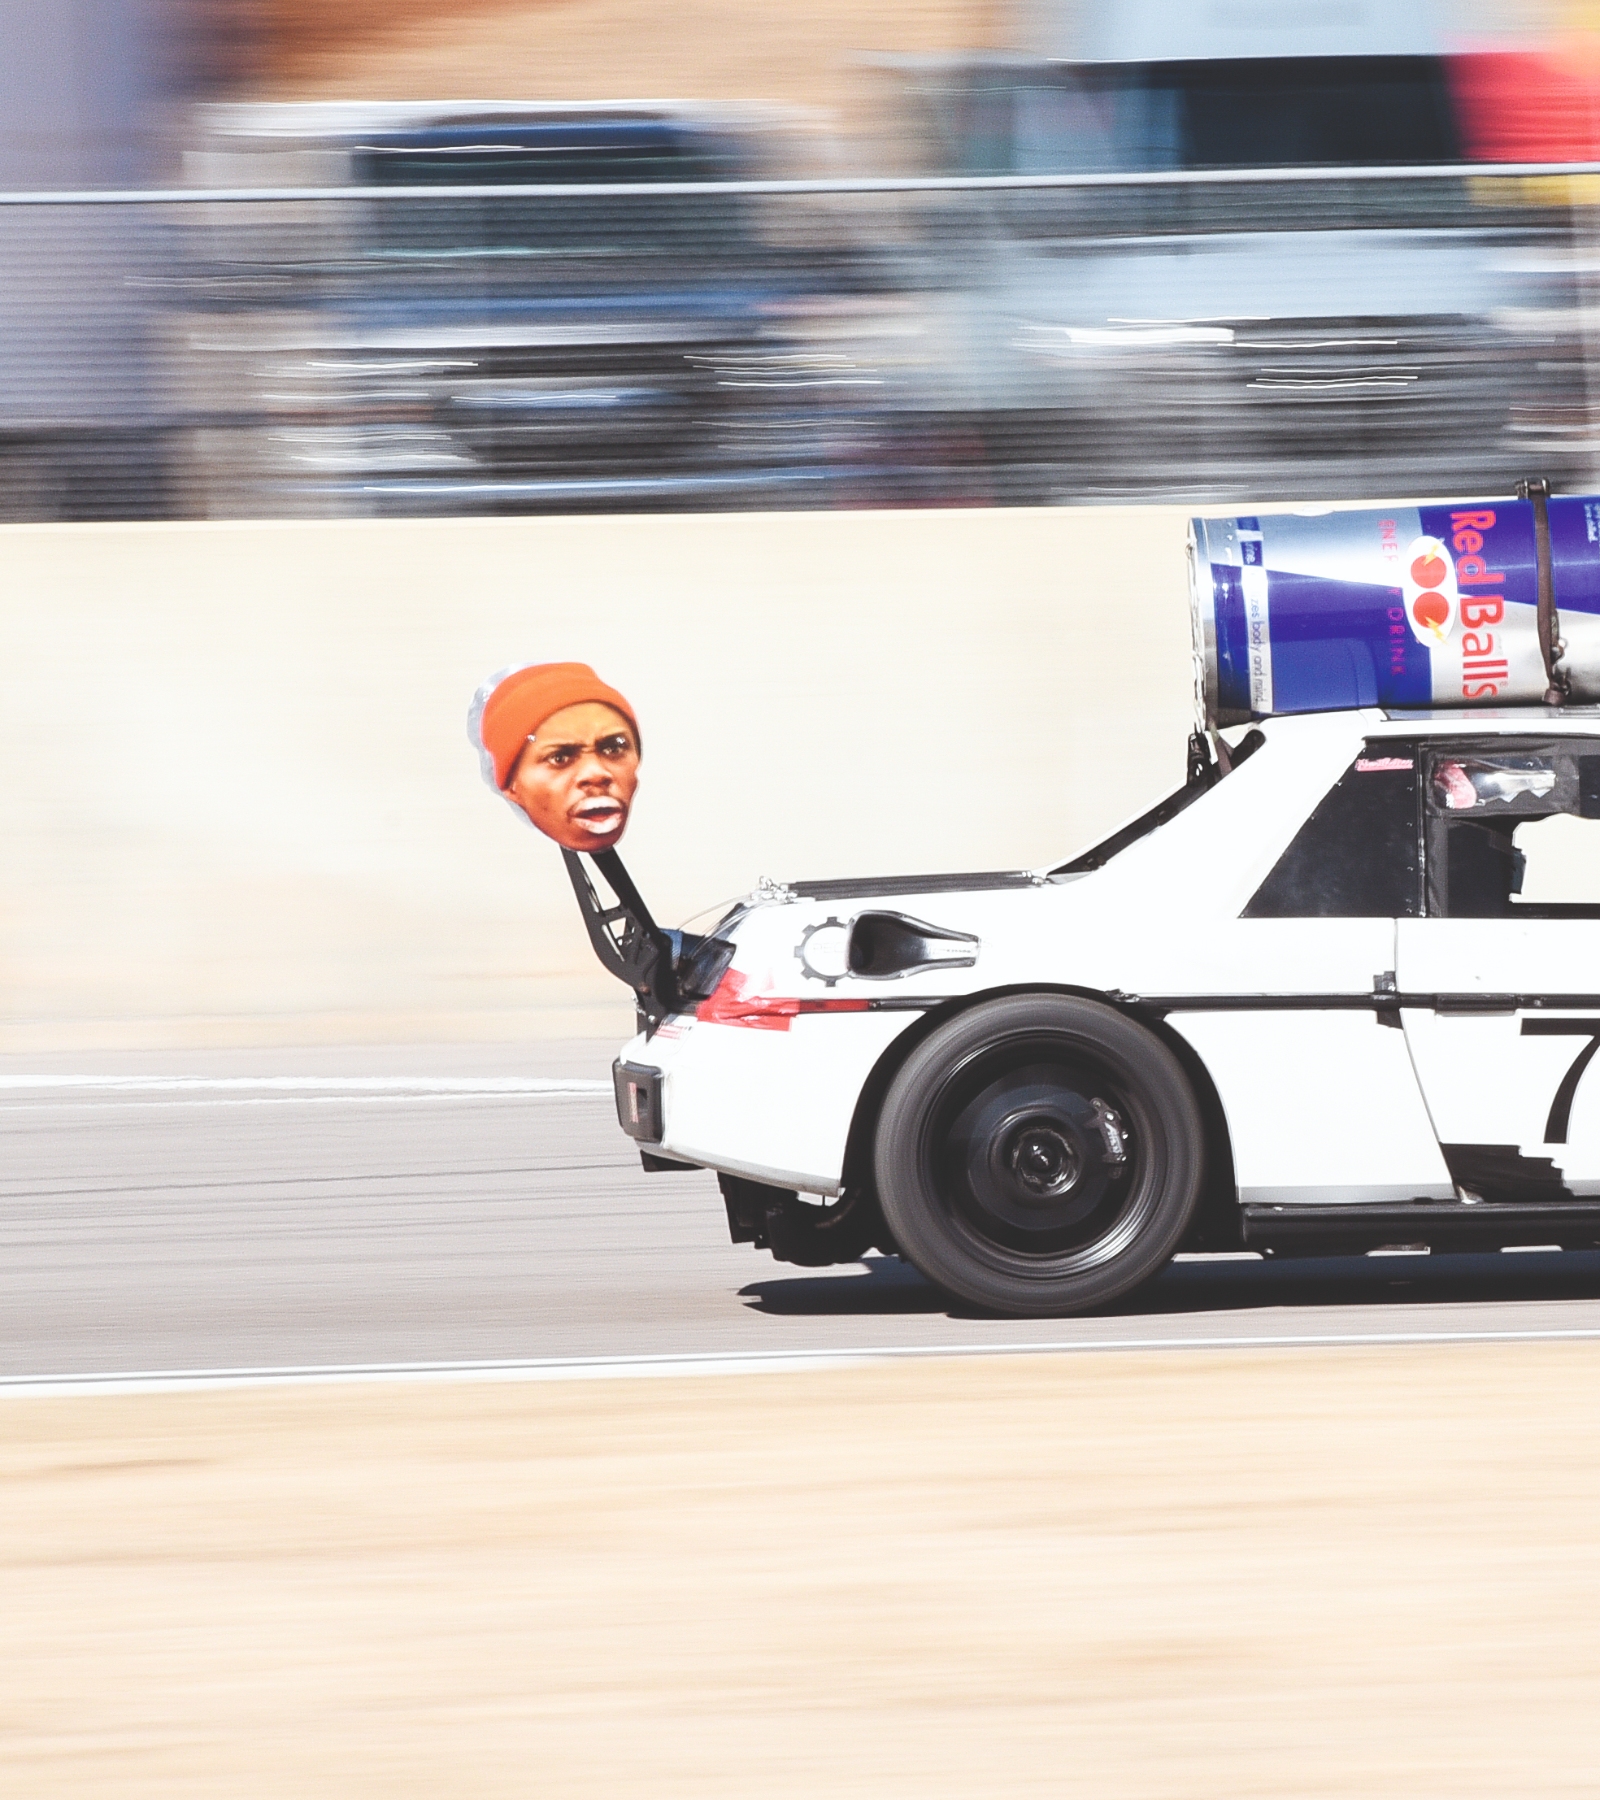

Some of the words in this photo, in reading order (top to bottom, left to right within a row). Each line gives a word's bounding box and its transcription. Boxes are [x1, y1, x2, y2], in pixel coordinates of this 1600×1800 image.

[1450, 510, 1506, 585] Red
[1250, 621, 1265, 652] body
[1254, 656, 1267, 676] and
[1387, 607, 1407, 675] DRINK
[1460, 595, 1508, 699] Balls
